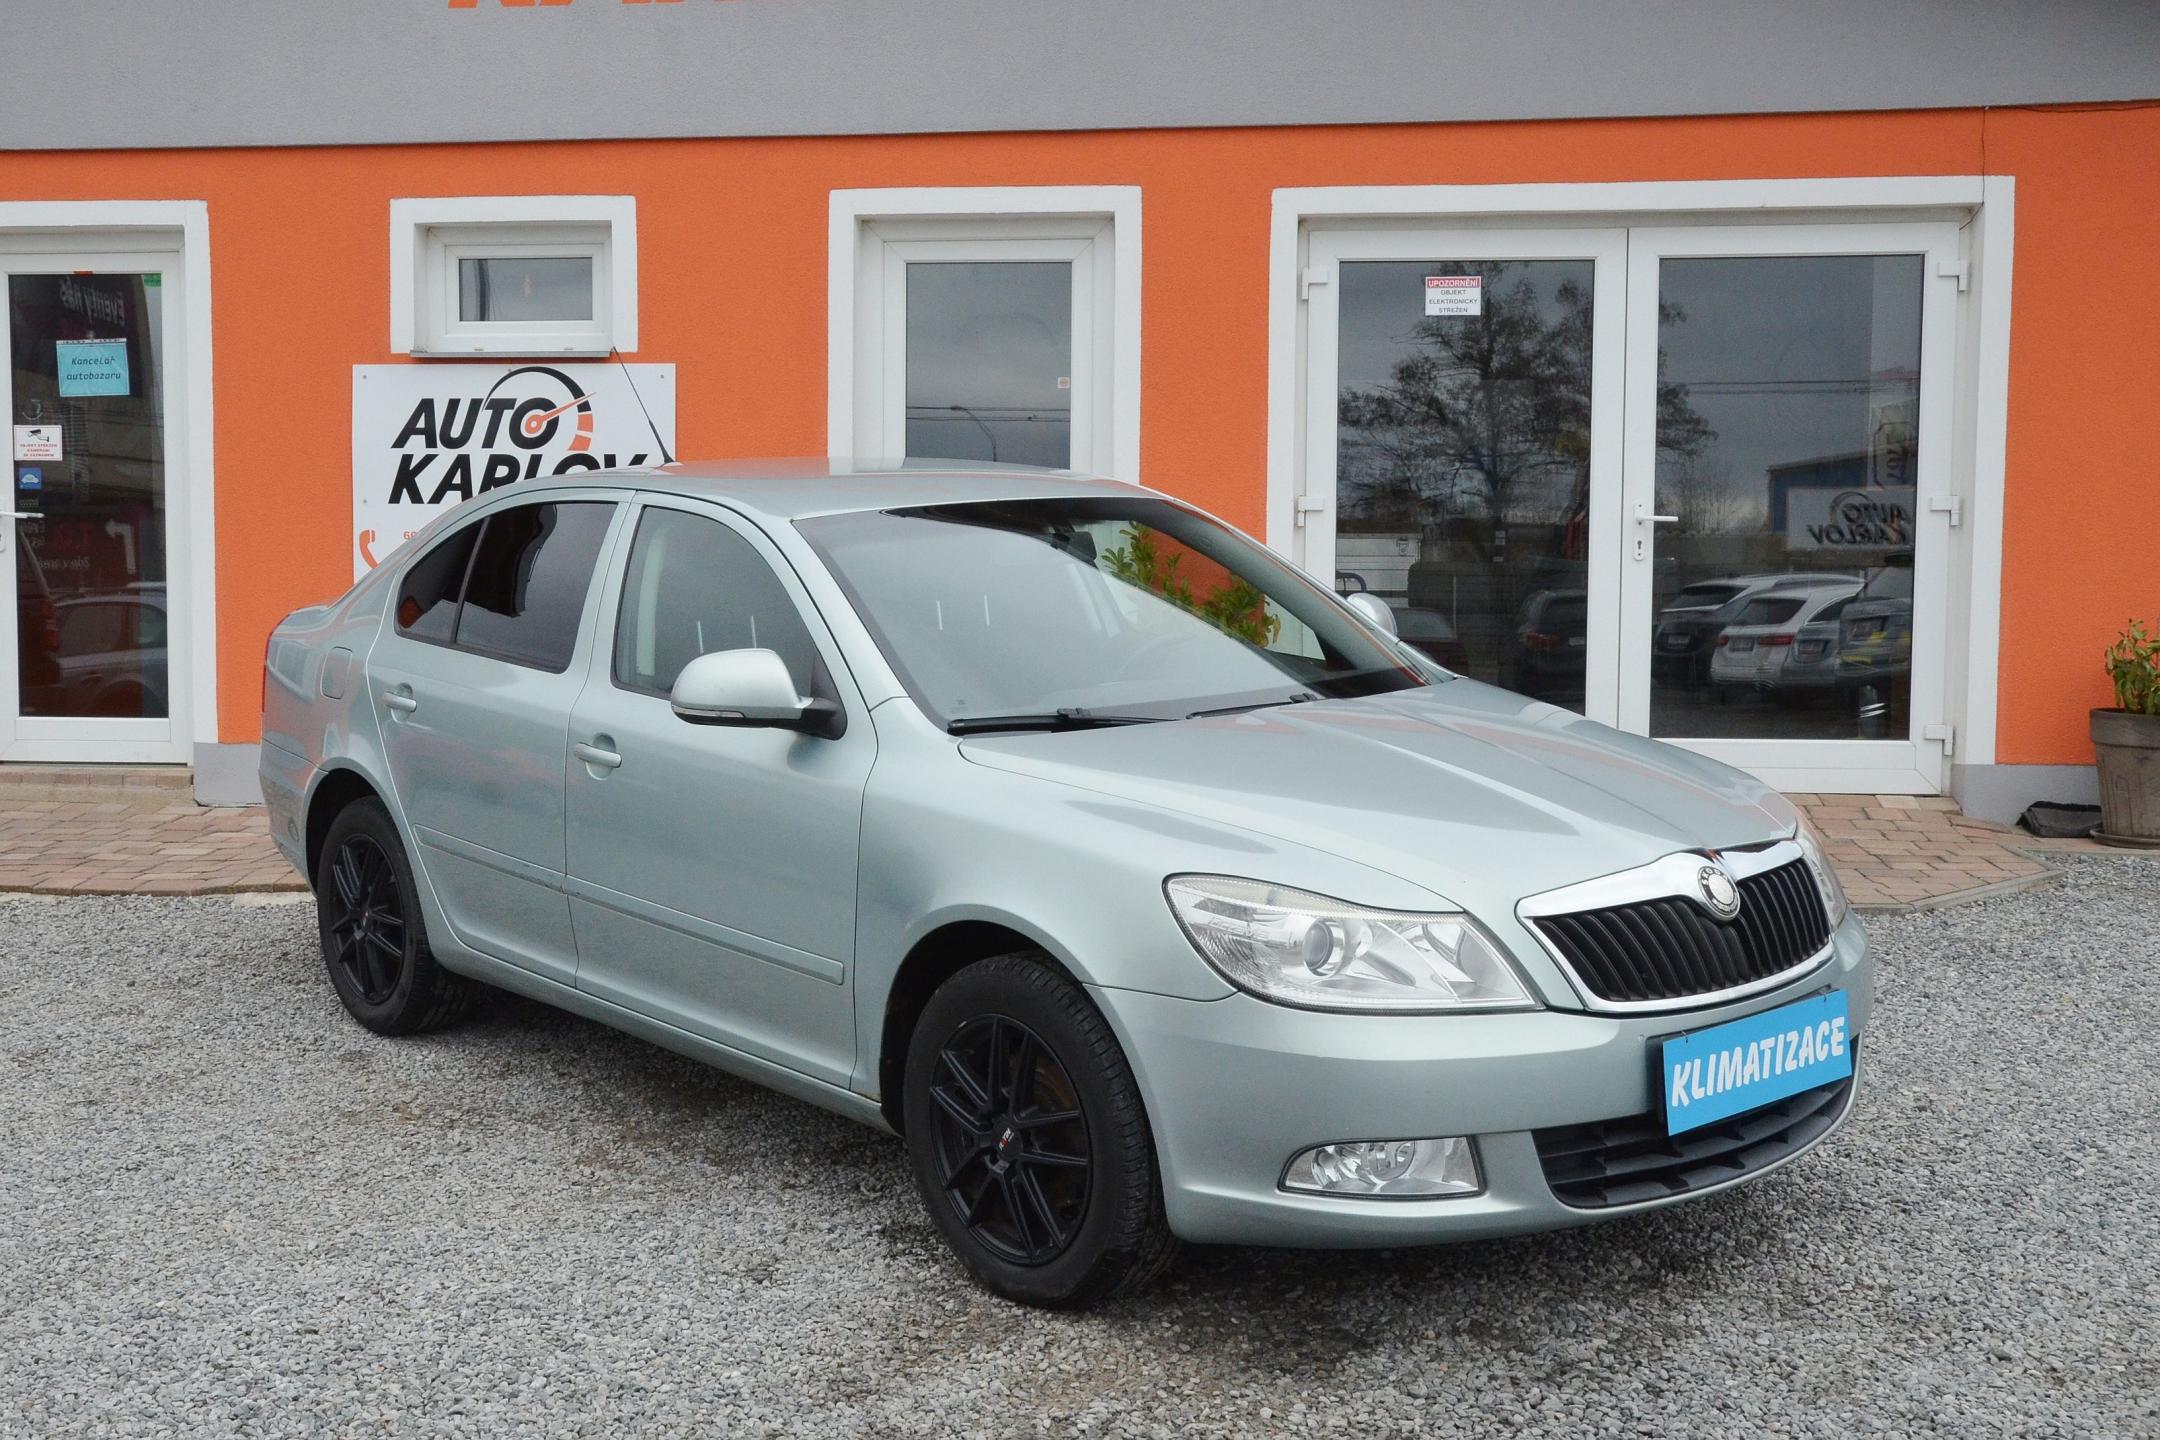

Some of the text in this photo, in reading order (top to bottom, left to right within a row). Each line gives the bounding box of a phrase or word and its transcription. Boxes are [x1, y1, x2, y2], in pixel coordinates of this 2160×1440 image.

[1428, 279, 1478, 288] UPOZORNĚNÍ
[66, 370, 121, 381] autobazaru
[390, 396, 561, 450] AUTO
[1670, 1016, 1846, 1108] KLIMATIZACE
